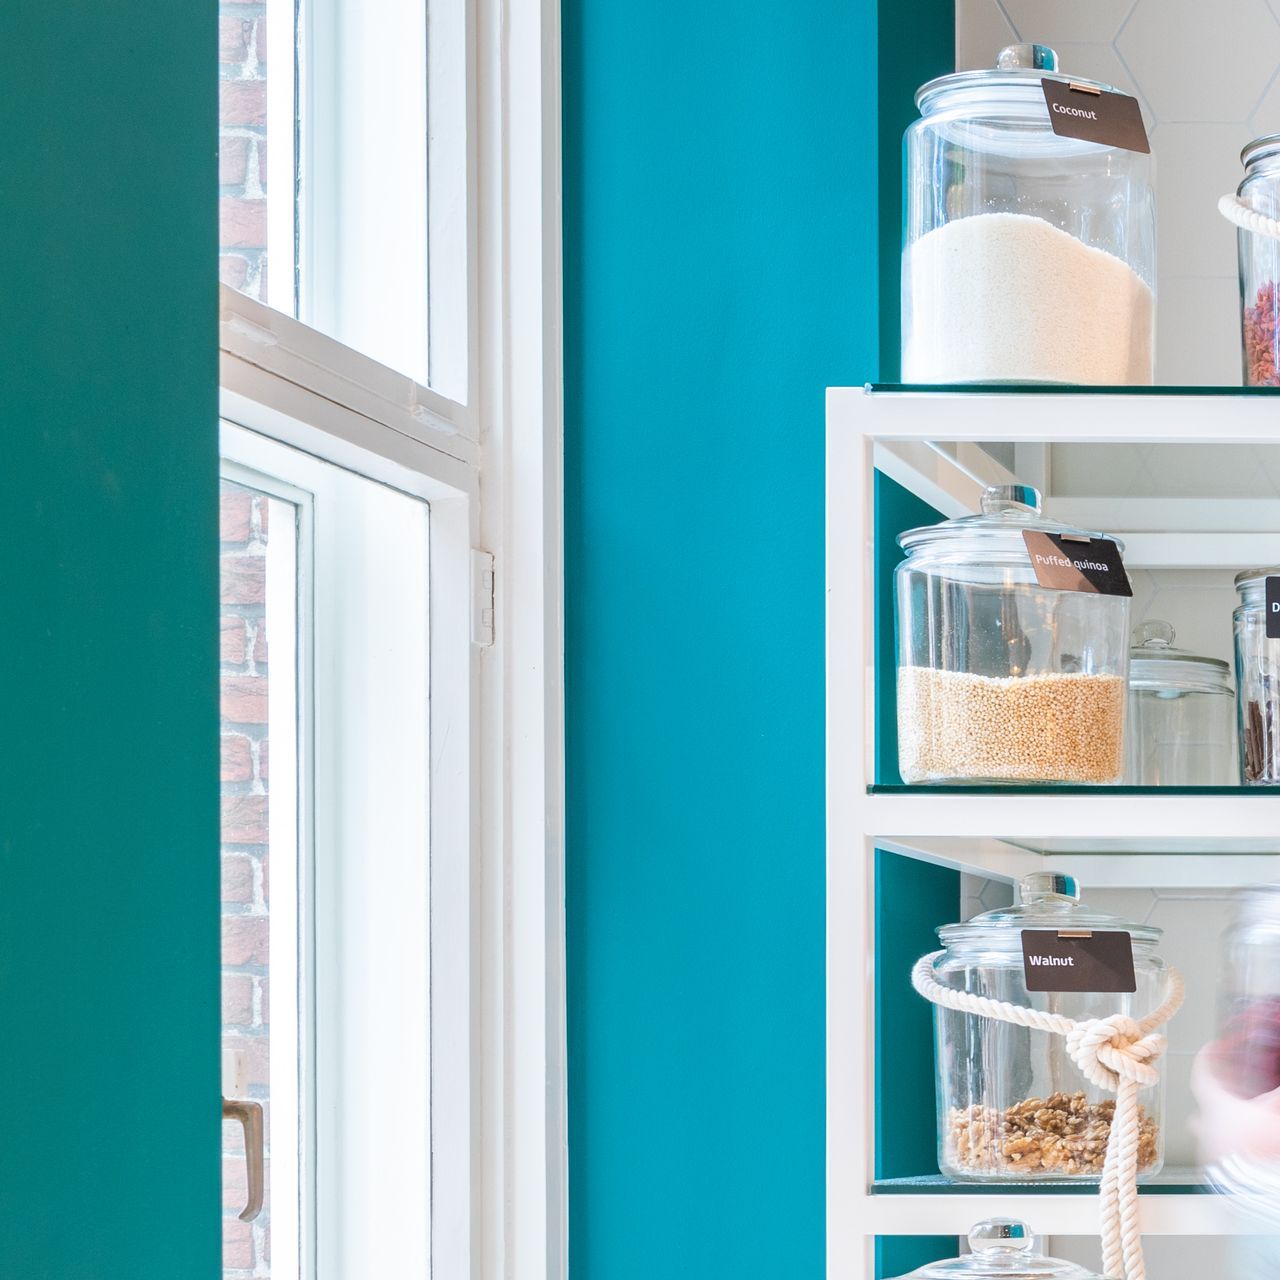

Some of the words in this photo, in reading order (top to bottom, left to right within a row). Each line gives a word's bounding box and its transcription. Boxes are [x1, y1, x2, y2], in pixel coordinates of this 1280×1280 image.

[1052, 102, 1098, 120] Coconut
[1035, 554, 1072, 568] Puffed
[1073, 559, 1109, 572] quinoa
[1028, 954, 1074, 967] Walnut
